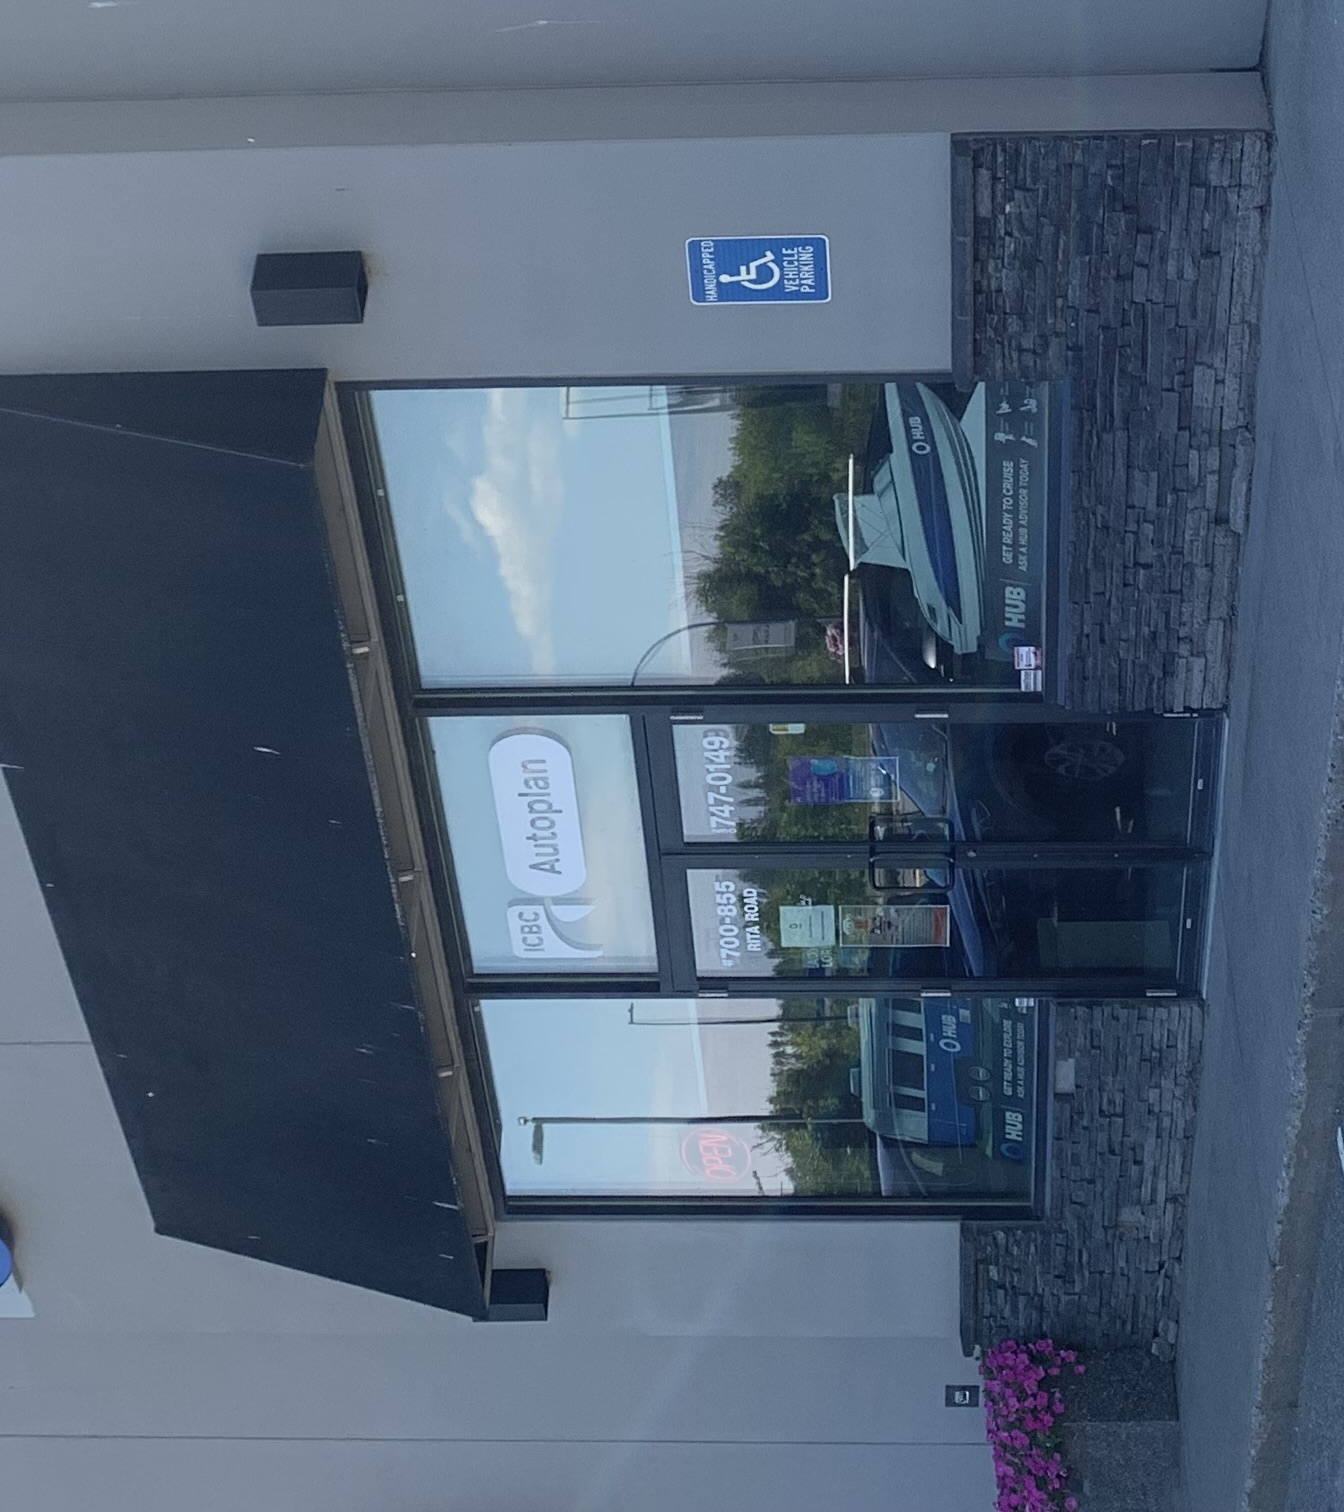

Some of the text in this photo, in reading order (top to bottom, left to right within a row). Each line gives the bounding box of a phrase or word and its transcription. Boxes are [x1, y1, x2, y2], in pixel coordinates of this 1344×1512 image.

[700, 240, 718, 301] HANDICAPPED
[782, 247, 800, 293] VEHICLE
[798, 245, 816, 293] PARKING
[908, 416, 925, 440] HUB
[1002, 460, 1014, 564] GET READY TO CRUISE
[1004, 586, 1026, 629] HUB
[702, 736, 736, 828] 747-0149
[517, 759, 563, 876] Autoplan
[518, 911, 545, 952] ICBC
[743, 887, 762, 951] RITA ROAD
[941, 1014, 957, 1038] HUB
[1004, 1111, 1023, 1141] HUB
[698, 1132, 737, 1180] OPEN
